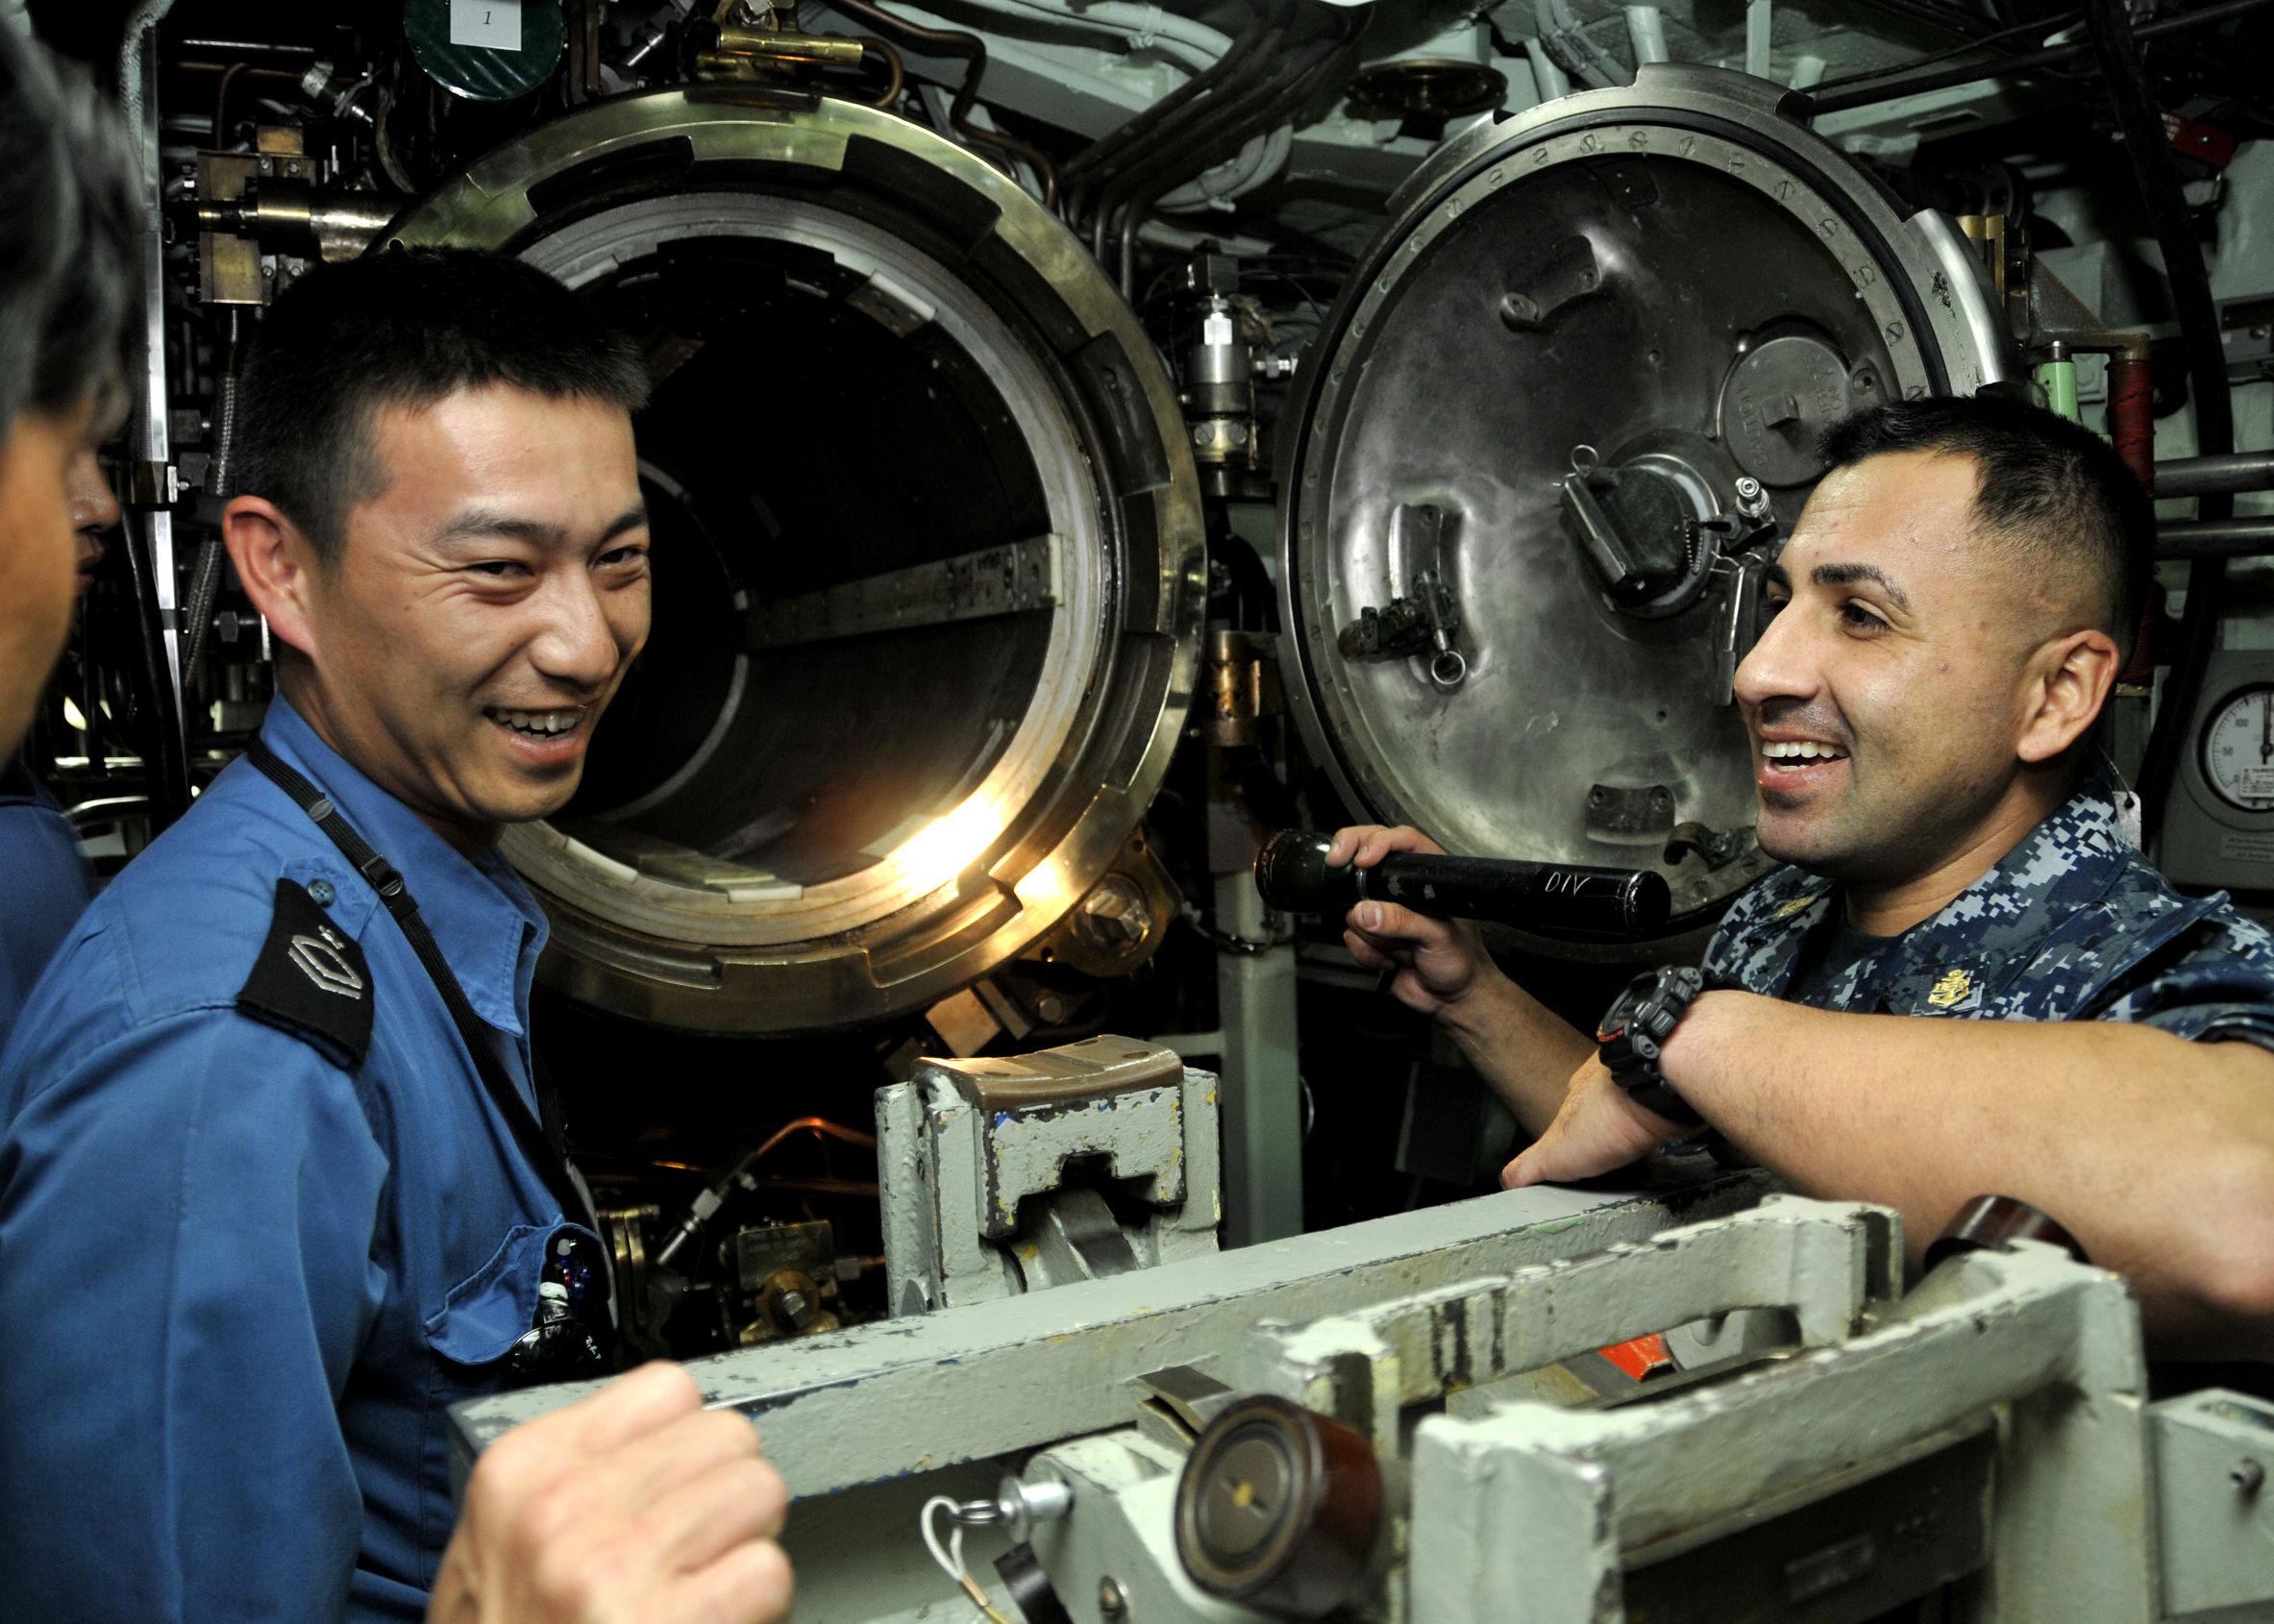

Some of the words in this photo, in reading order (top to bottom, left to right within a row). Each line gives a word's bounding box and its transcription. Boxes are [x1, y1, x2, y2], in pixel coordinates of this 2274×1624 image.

[482, 11, 492, 25] 1
[1737, 385, 1768, 467] CAUTION
[2235, 718, 2250, 728] 100
[2222, 746, 2235, 757] 50
